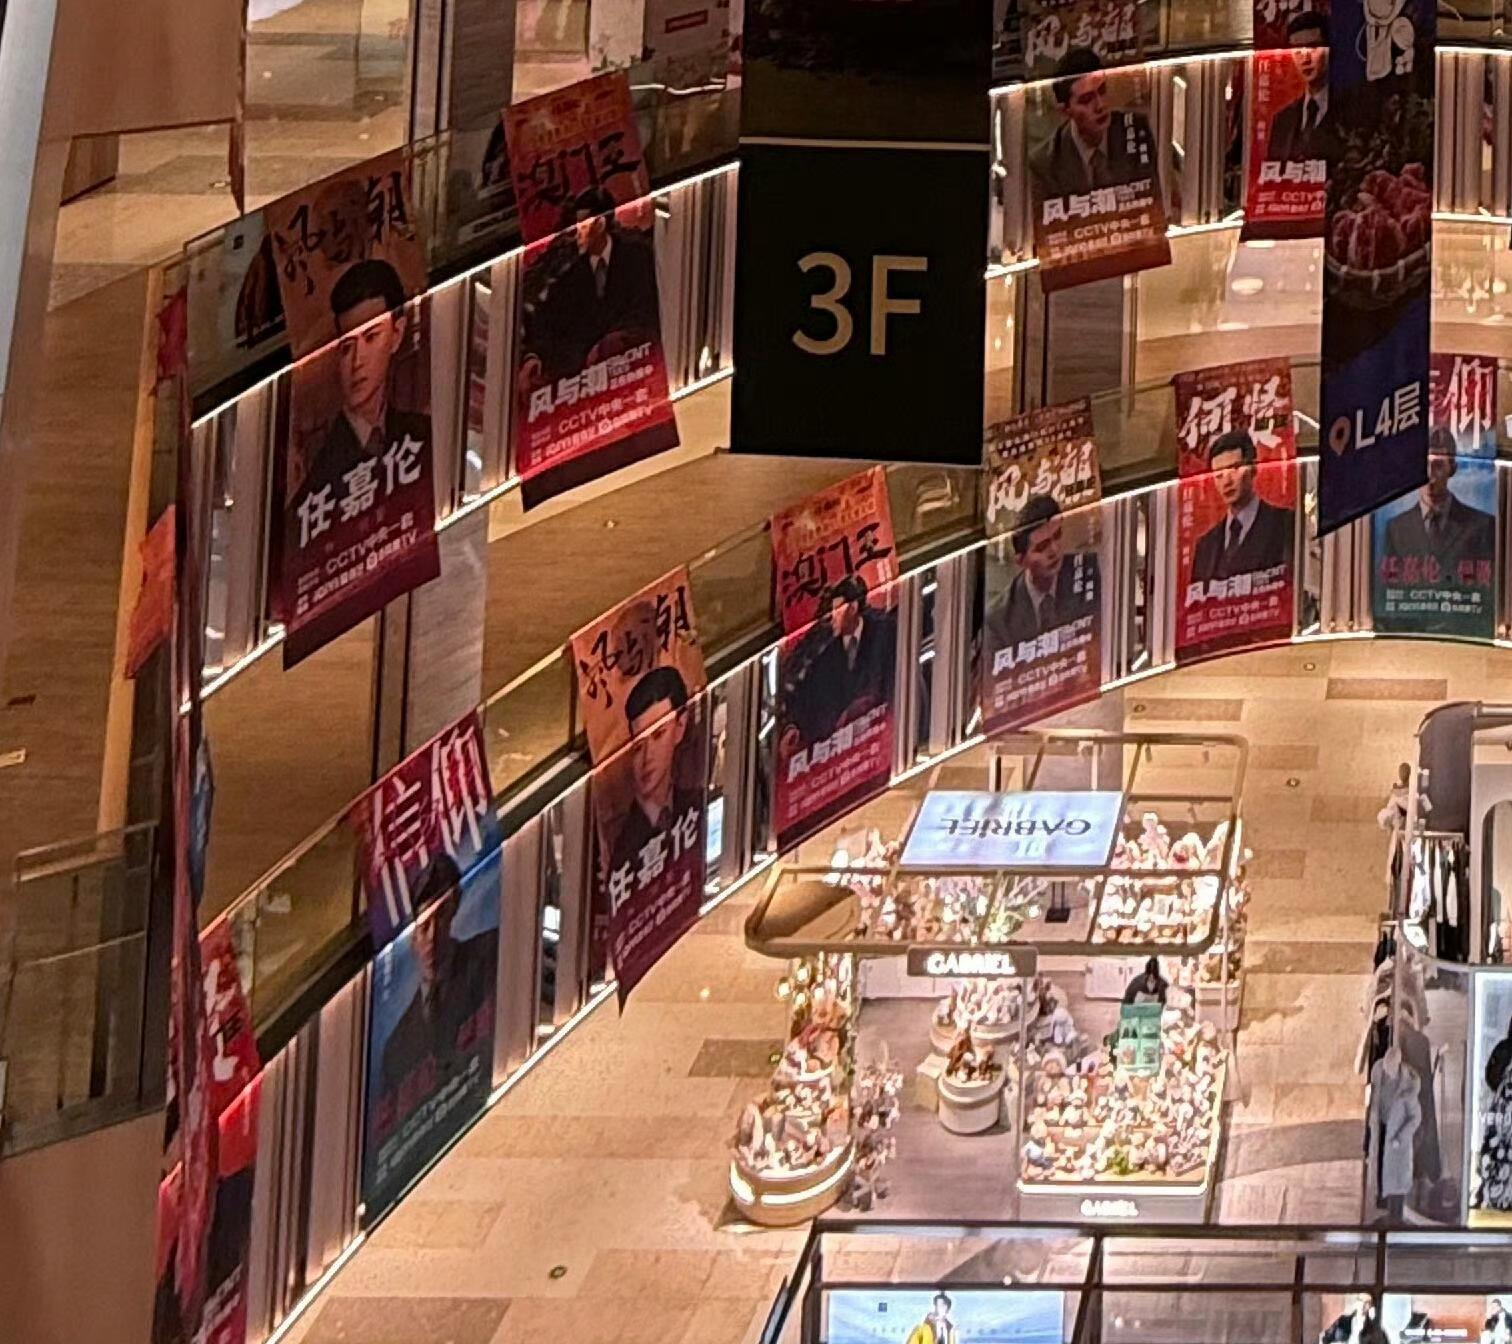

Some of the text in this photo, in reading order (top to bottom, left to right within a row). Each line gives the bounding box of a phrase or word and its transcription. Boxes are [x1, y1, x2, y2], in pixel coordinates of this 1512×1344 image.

[792, 250, 929, 357] 3F
[1355, 380, 1421, 450] L4层
[299, 433, 425, 549] 任嘉伦
[608, 809, 699, 914] 任嘉伦
